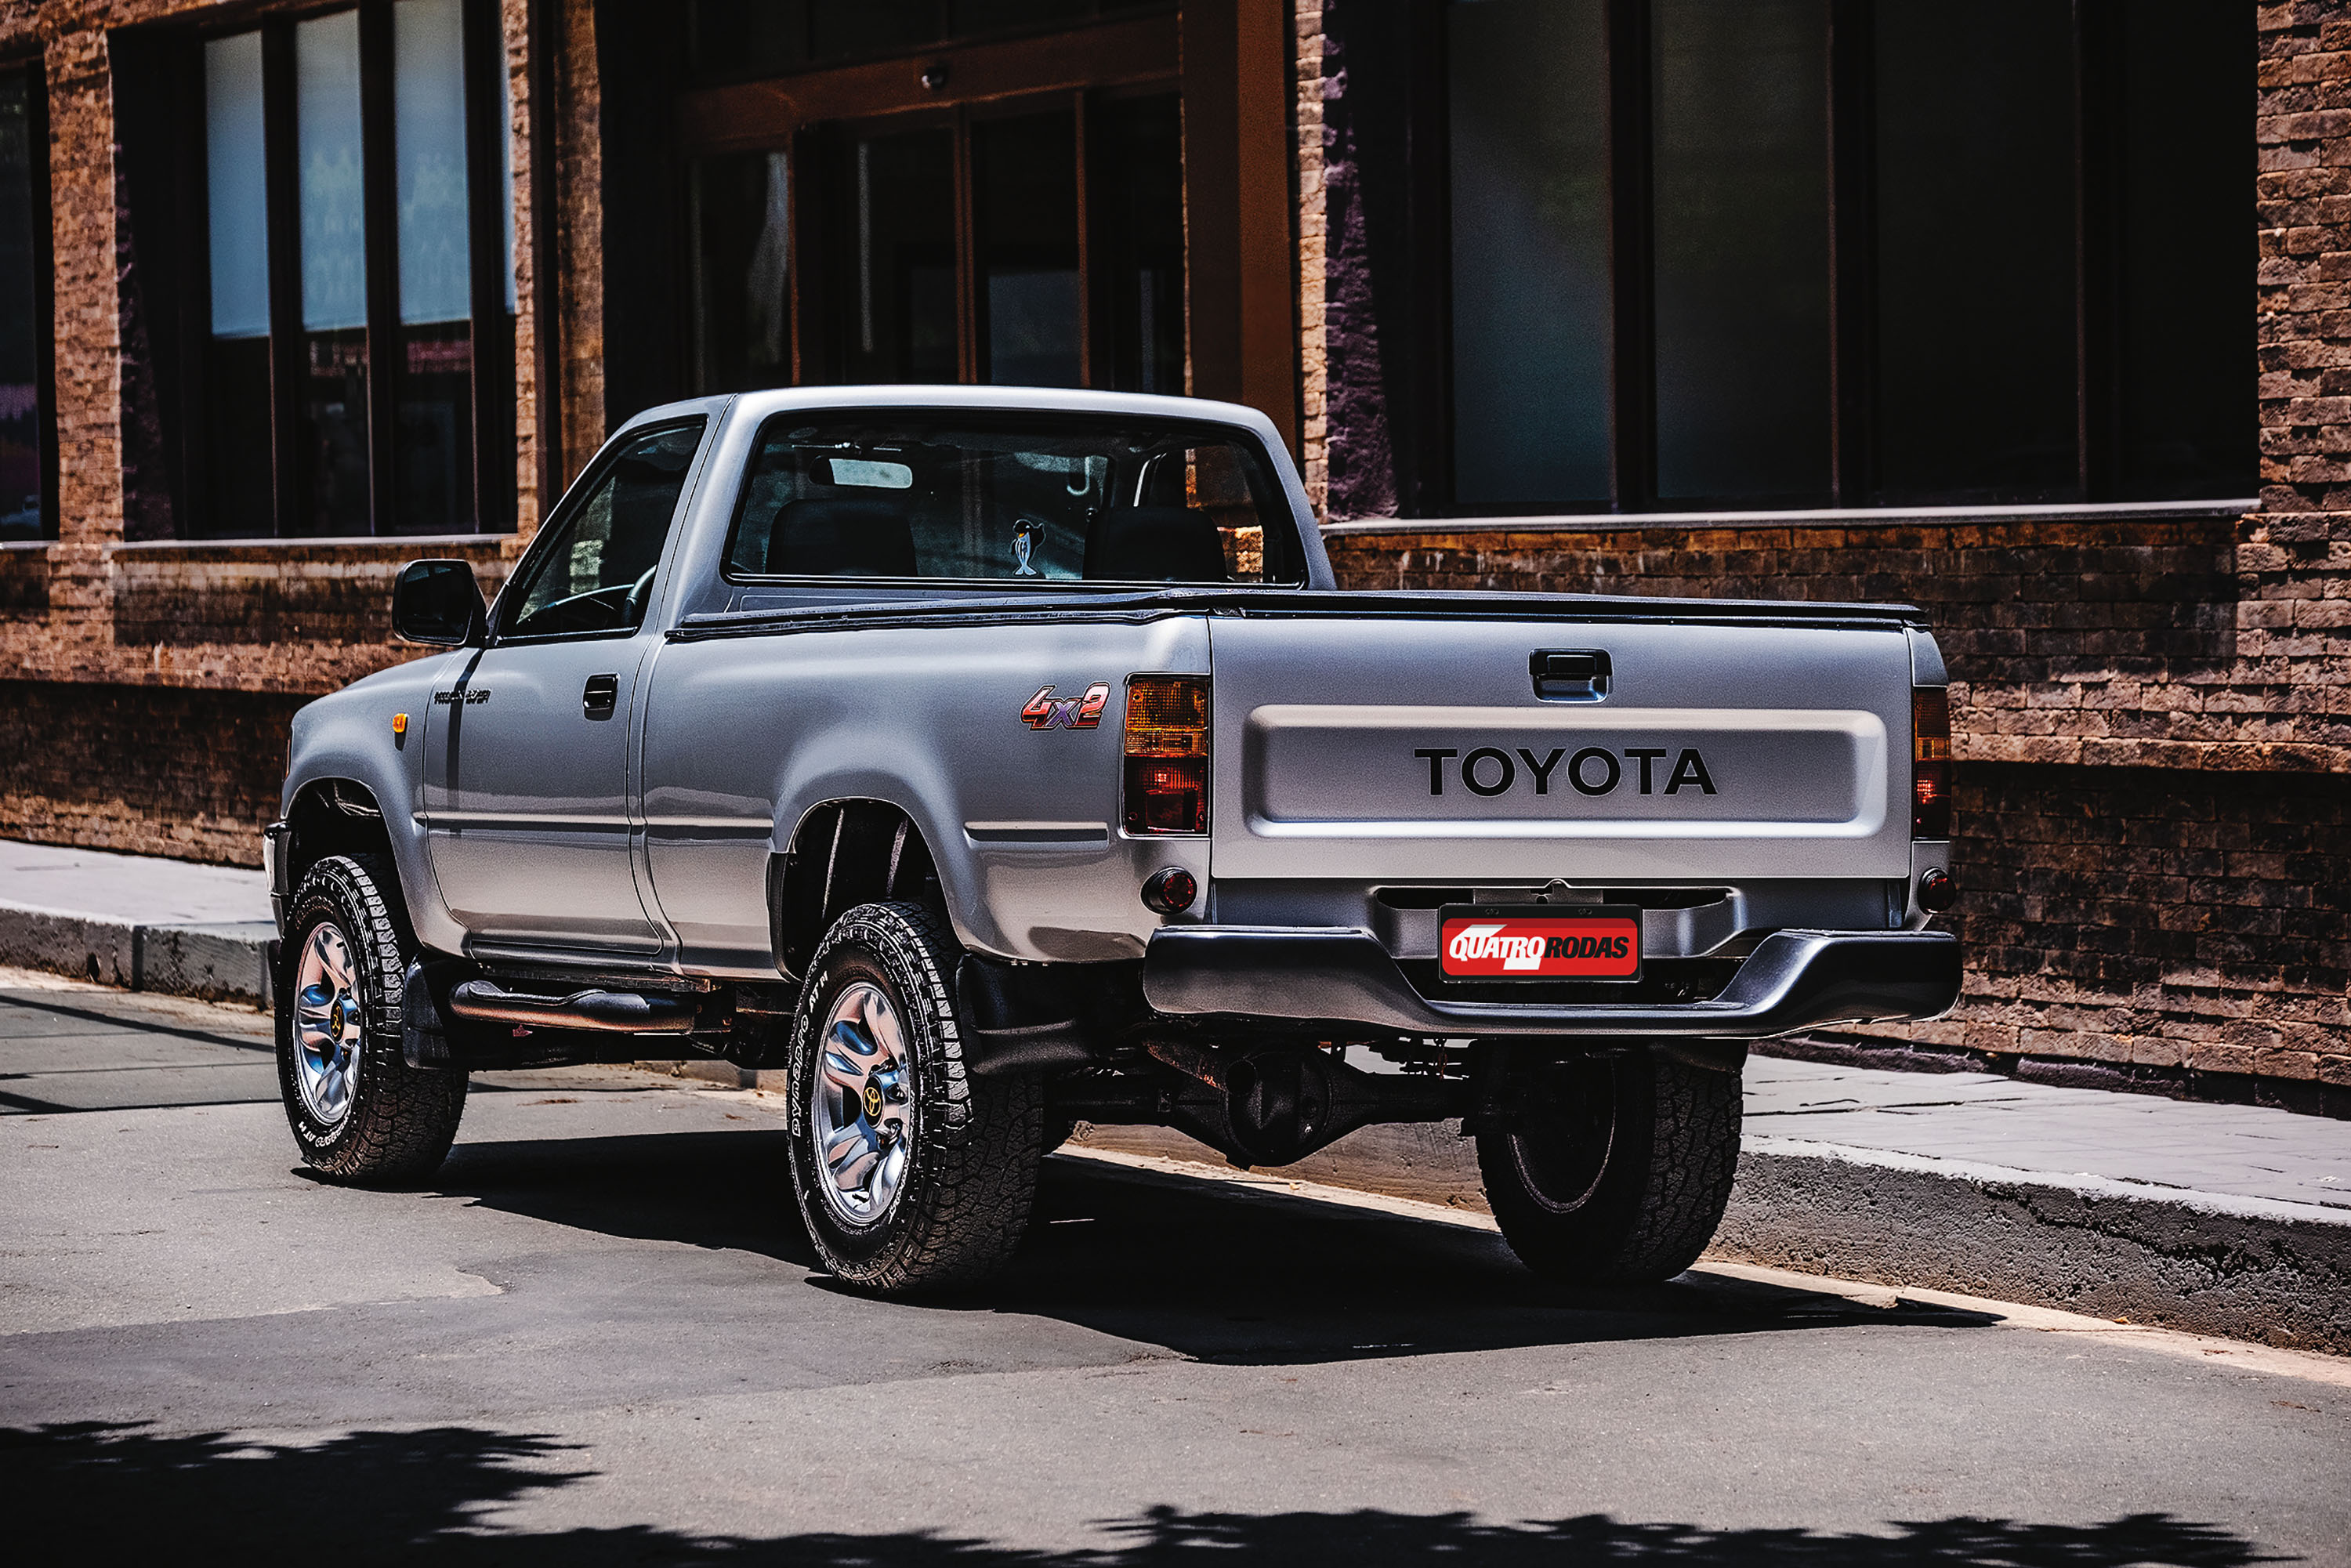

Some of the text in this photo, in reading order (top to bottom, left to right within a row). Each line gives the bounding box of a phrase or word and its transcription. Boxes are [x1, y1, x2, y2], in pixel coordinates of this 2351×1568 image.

[1414, 747, 1719, 797] TOYOTA
[1449, 936, 1629, 961] QUATRO RODAS
